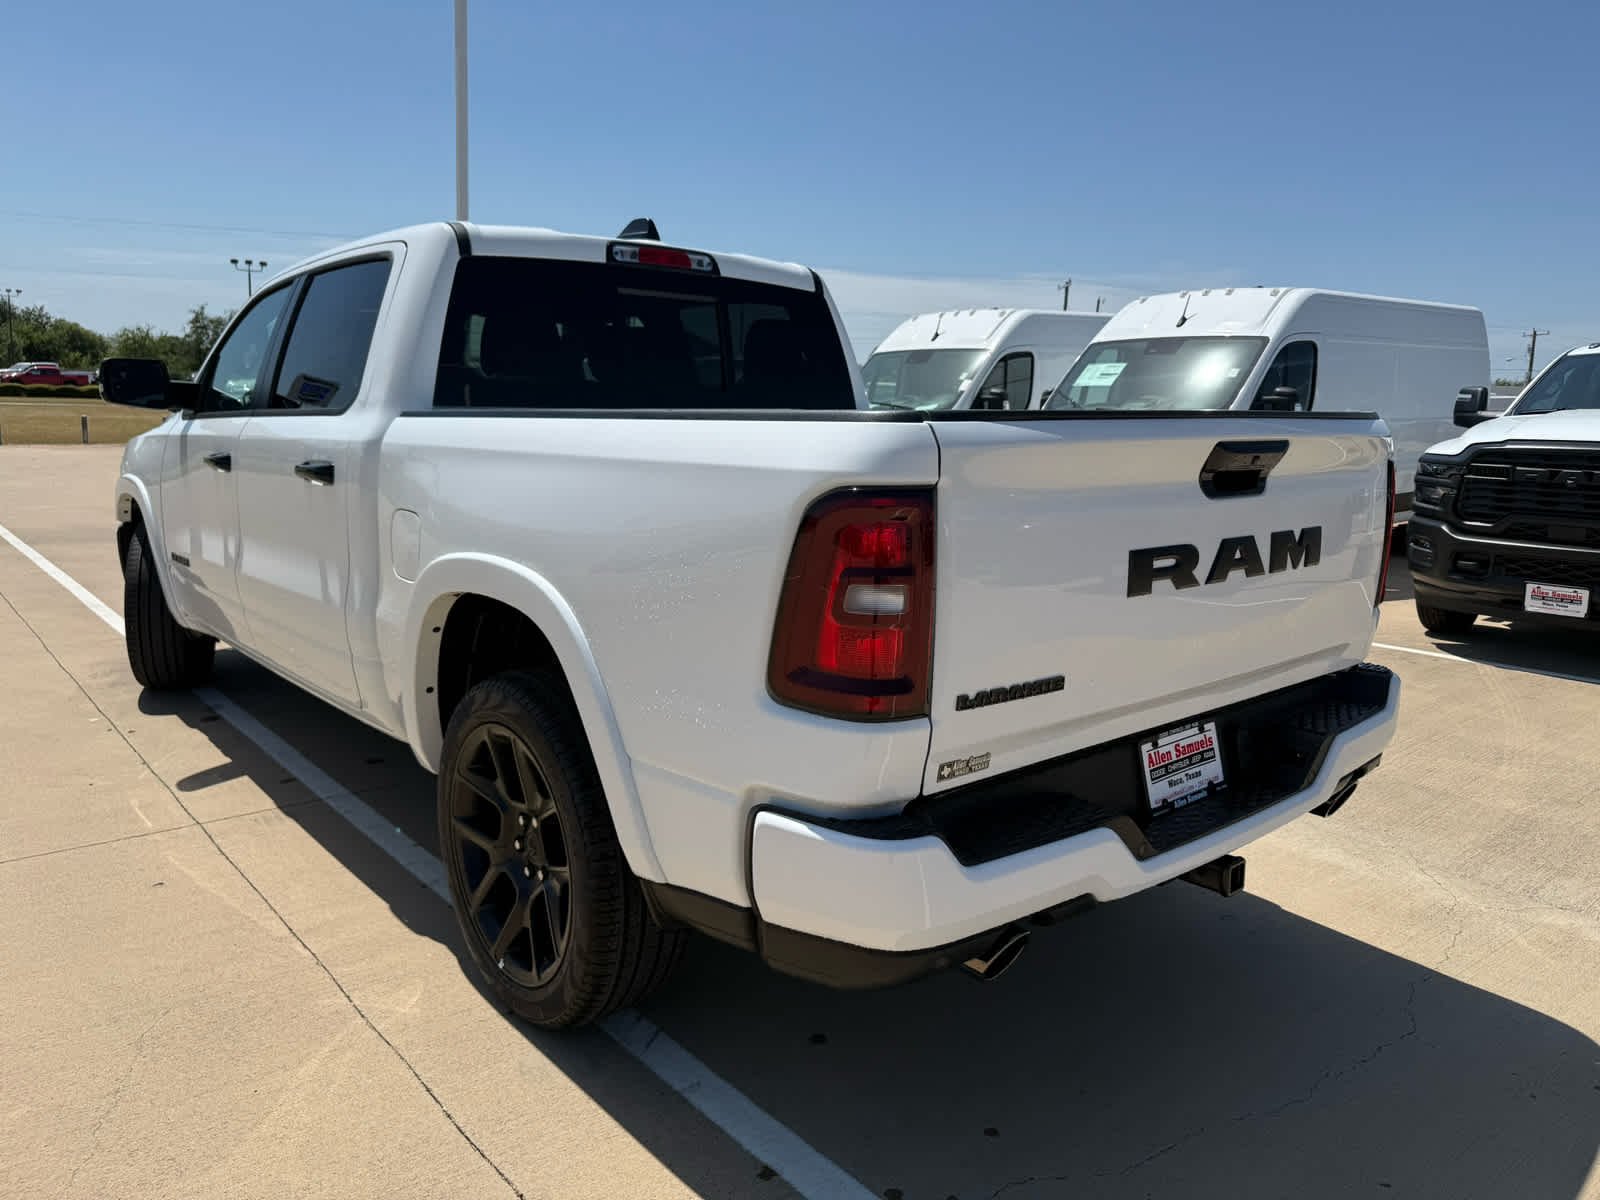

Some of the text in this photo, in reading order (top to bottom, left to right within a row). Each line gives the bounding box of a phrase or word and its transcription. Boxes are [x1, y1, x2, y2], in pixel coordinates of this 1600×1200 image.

[1127, 526, 1322, 597] RAM
[1147, 734, 1214, 768] Allen Samuels
